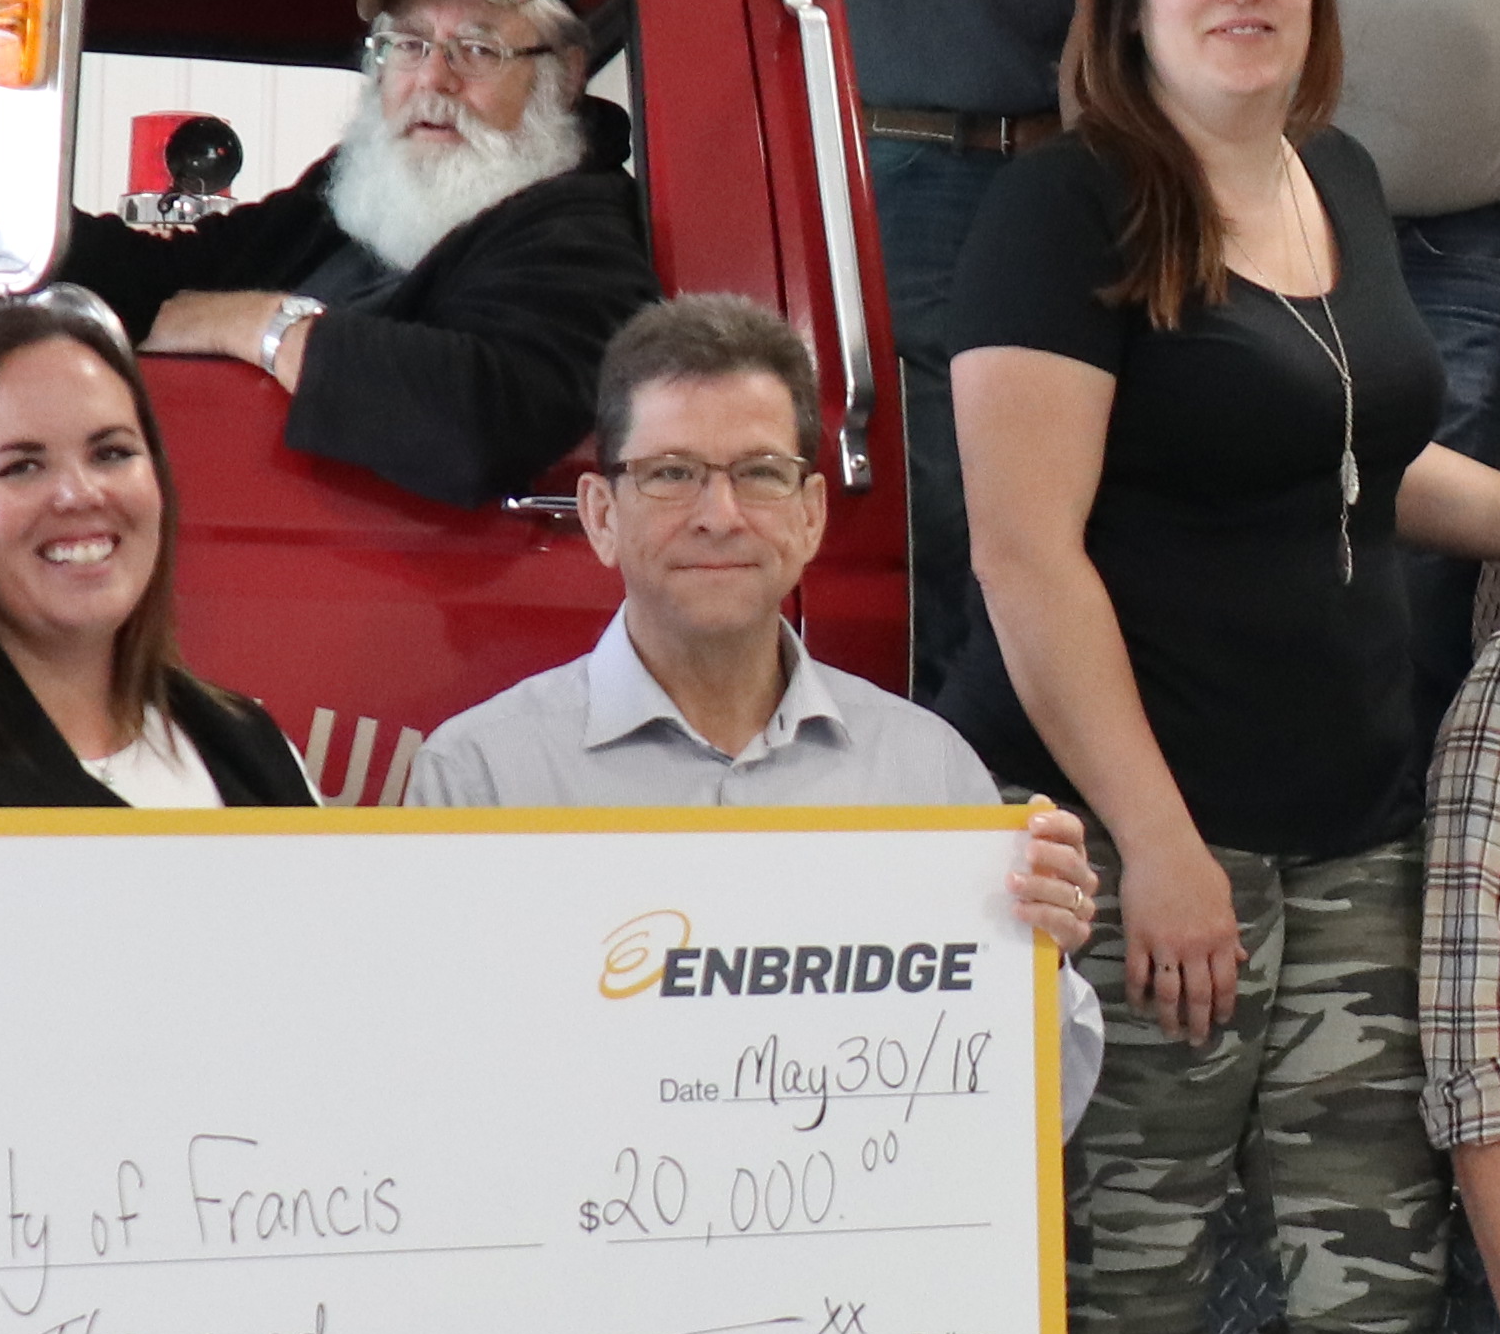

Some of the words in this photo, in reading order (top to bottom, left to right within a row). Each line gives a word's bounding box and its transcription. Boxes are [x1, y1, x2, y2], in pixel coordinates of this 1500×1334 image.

[659, 942, 979, 998] ENBRIDGE
[659, 1078, 719, 1103] Date
[91, 1160, 143, 1257] of
[188, 1134, 400, 1245] Francis
